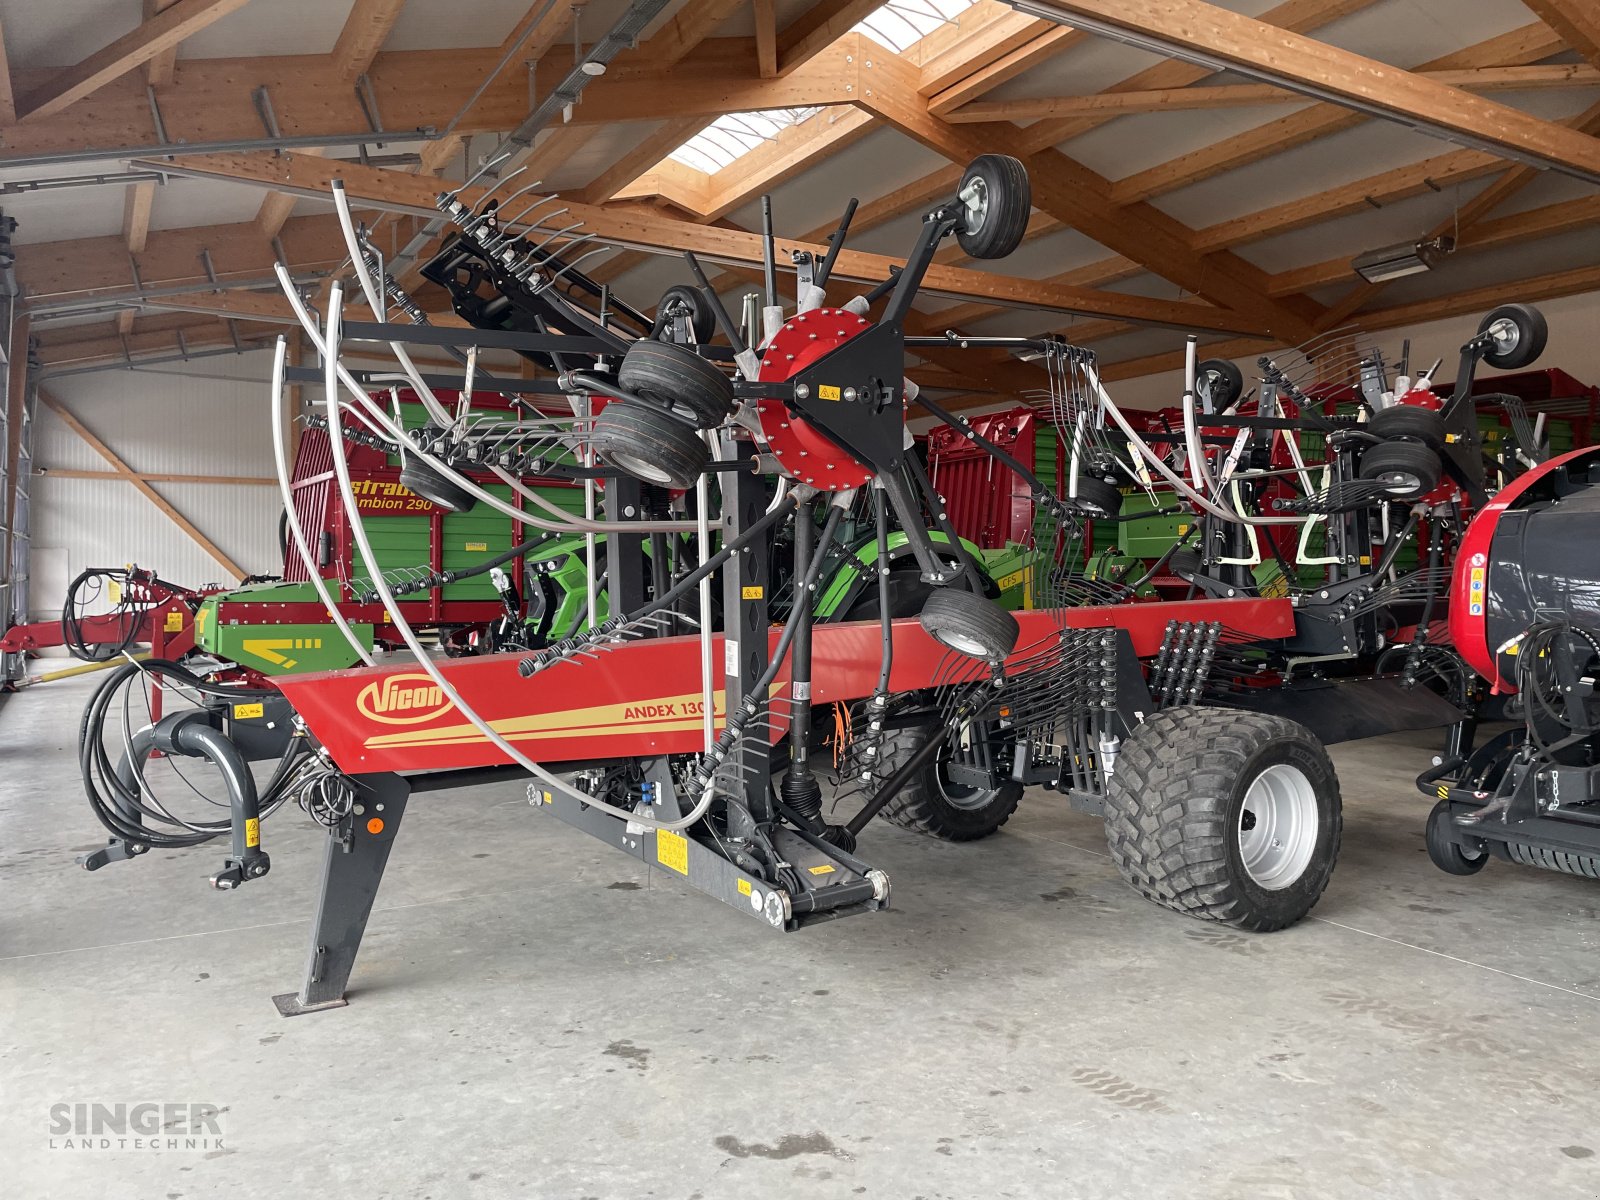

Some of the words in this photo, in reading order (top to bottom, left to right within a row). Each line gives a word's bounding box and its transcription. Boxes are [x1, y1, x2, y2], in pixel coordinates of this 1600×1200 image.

[406, 499, 433, 511] 290
[1002, 575, 1017, 588] CFS
[373, 677, 443, 712] Vicon
[624, 704, 676, 720] ANDEX
[681, 702, 717, 715] 130
